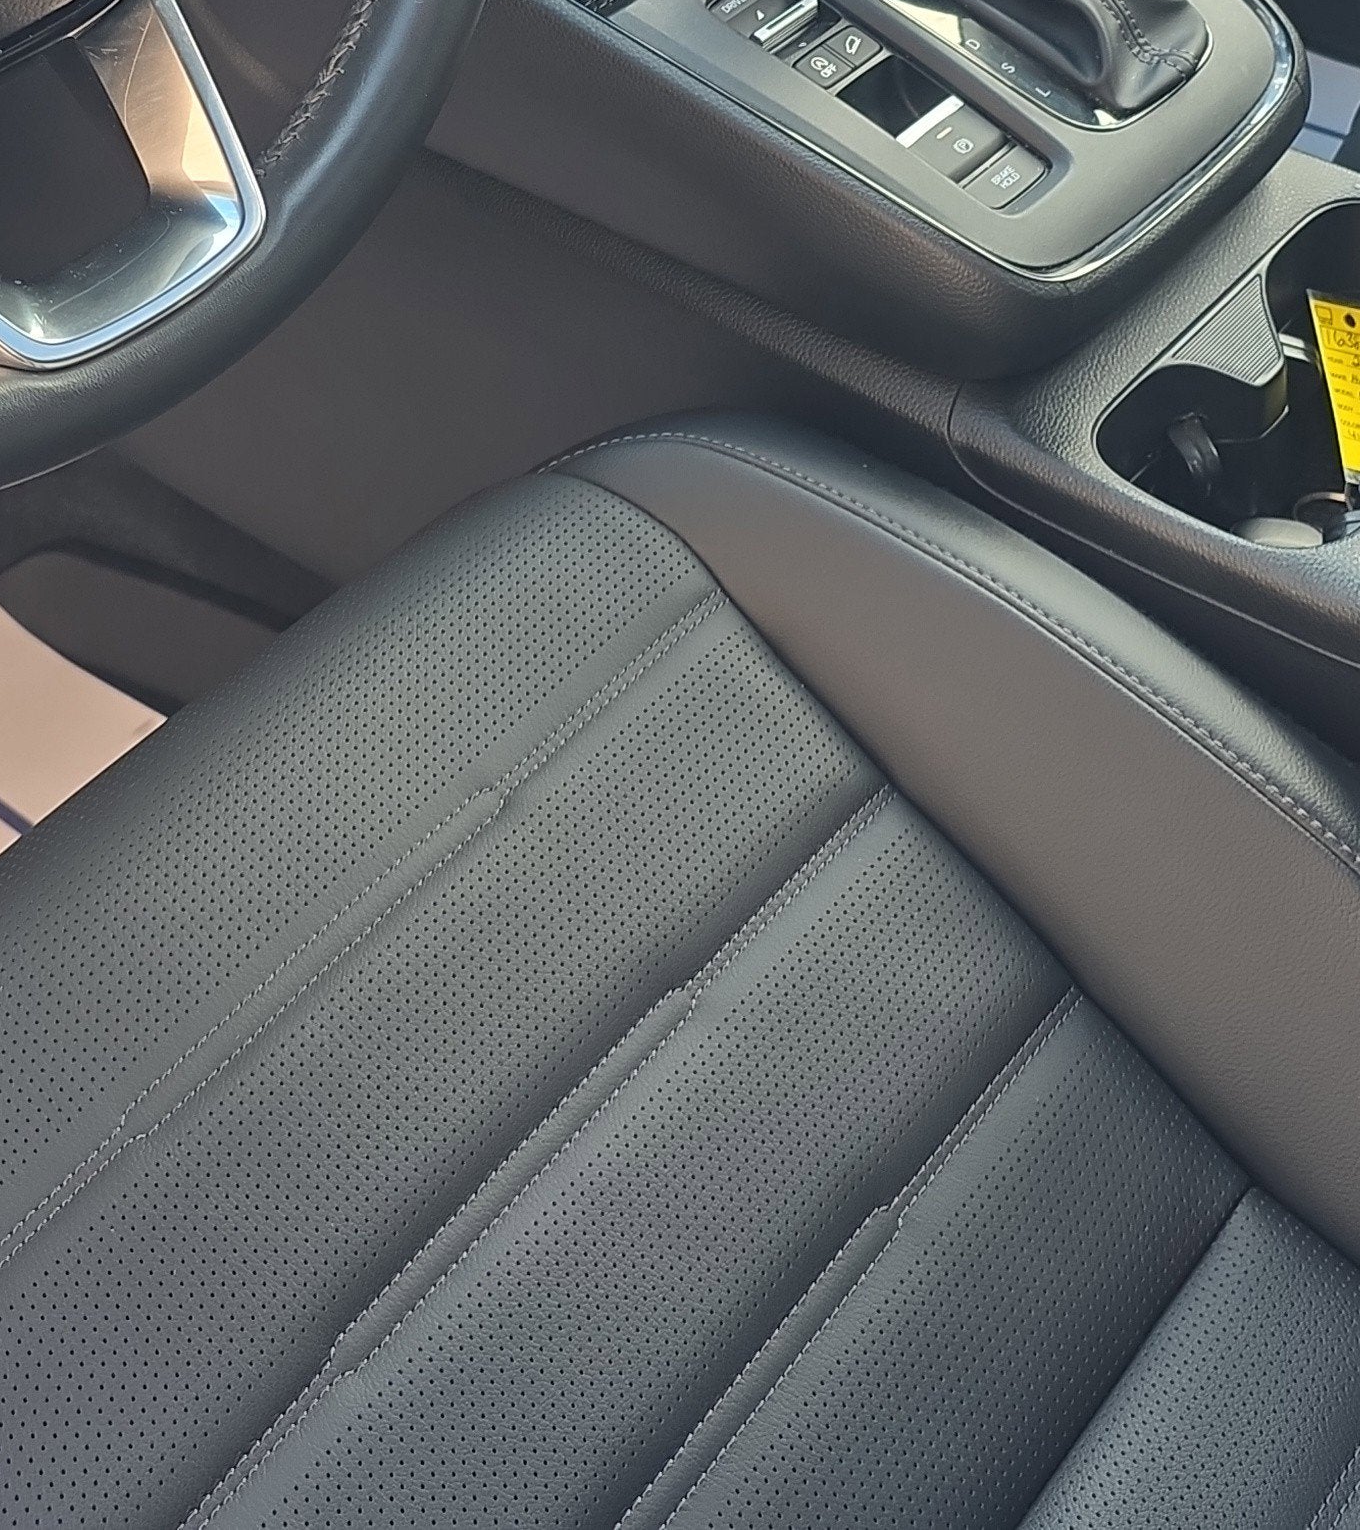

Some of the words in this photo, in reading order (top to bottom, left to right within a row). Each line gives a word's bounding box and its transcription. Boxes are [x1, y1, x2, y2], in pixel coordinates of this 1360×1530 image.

[965, 38, 981, 51] D
[1001, 62, 1015, 74] S
[1035, 86, 1051, 98] L
[991, 165, 1016, 185] BRAKE
[1001, 172, 1021, 189] HOLD
